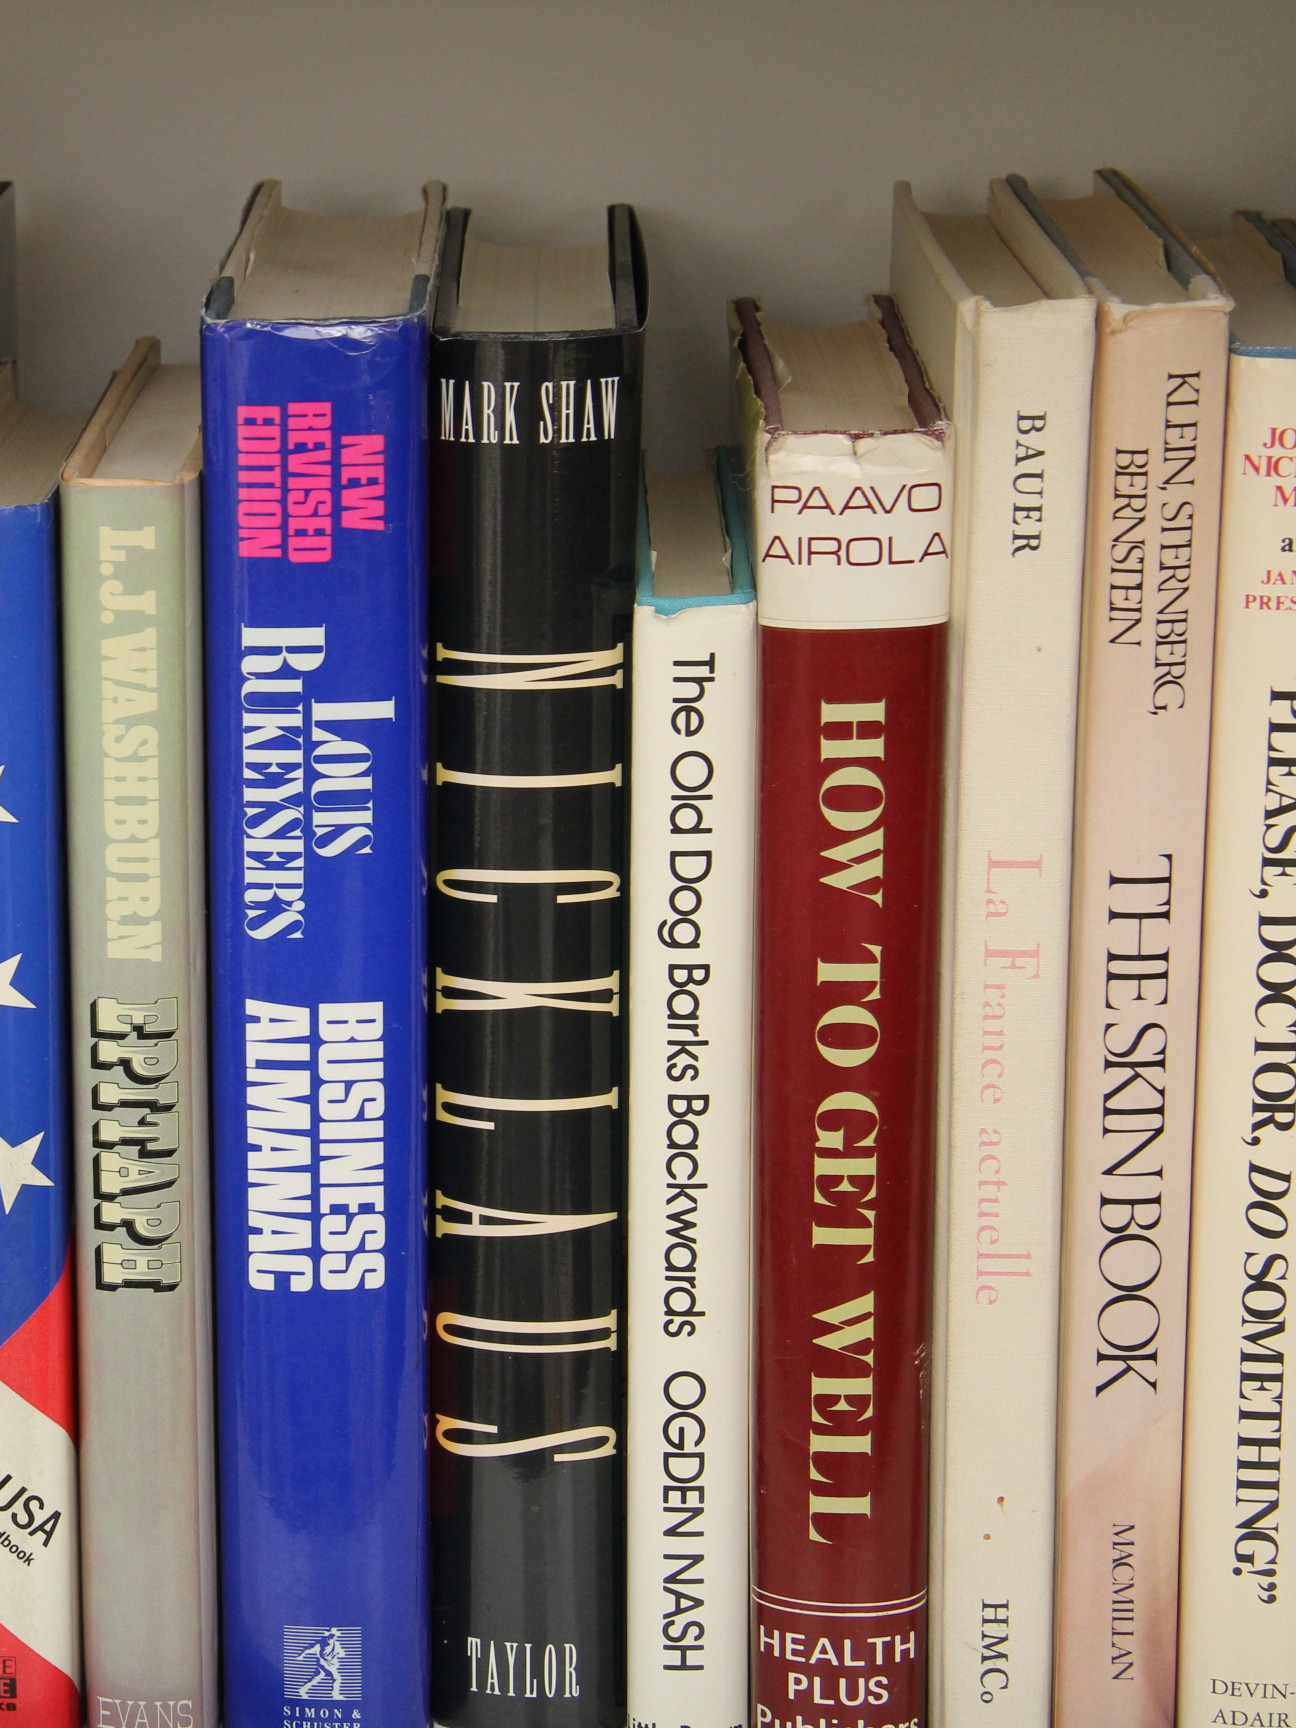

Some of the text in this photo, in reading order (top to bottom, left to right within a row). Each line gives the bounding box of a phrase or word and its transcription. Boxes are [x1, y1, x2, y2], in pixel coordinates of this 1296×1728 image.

[237, 405, 281, 558] EDITION
[288, 402, 332, 563] REVISED
[341, 434, 385, 531] NEW
[440, 376, 619, 446] MARK SHAW
[1012, 410, 1047, 557] BAUER
[762, 533, 949, 566] AIROLA
[771, 482, 943, 515] PAAVO
[1108, 447, 1149, 647] BERNSTEIN
[1146, 370, 1201, 716] KLEIN, STERNBERG,
[101, 627, 163, 963] WASHBURN
[311, 696, 395, 857] LOUIS
[436, 643, 624, 1463] NICKLAUS
[976, 850, 1043, 1306] La France actuelle
[1241, 911, 1296, 1146] DOCTOR,
[90, 997, 182, 1292] EPITAPH
[246, 999, 312, 1292] ALMANAC
[318, 1001, 385, 1290] BUSINESS
[657, 653, 716, 1672] The Old Dog Barks Backwards OGDEN NASH
[808, 698, 886, 1545] HOW TO GET WELL
[1095, 853, 1173, 1398] THE SKIN BOOK
[1245, 1159, 1292, 1239] DO
[467, 1636, 580, 1700] TAYLOR
[759, 1624, 915, 1667] HEALTH
[1112, 1522, 1136, 1682] MACMILLAN
[96, 1696, 194, 1728] EVANS
[284, 1706, 361, 1719] SIMON &
[788, 1672, 889, 1706] PLUS
[1211, 1708, 1292, 1728] ADAIR
